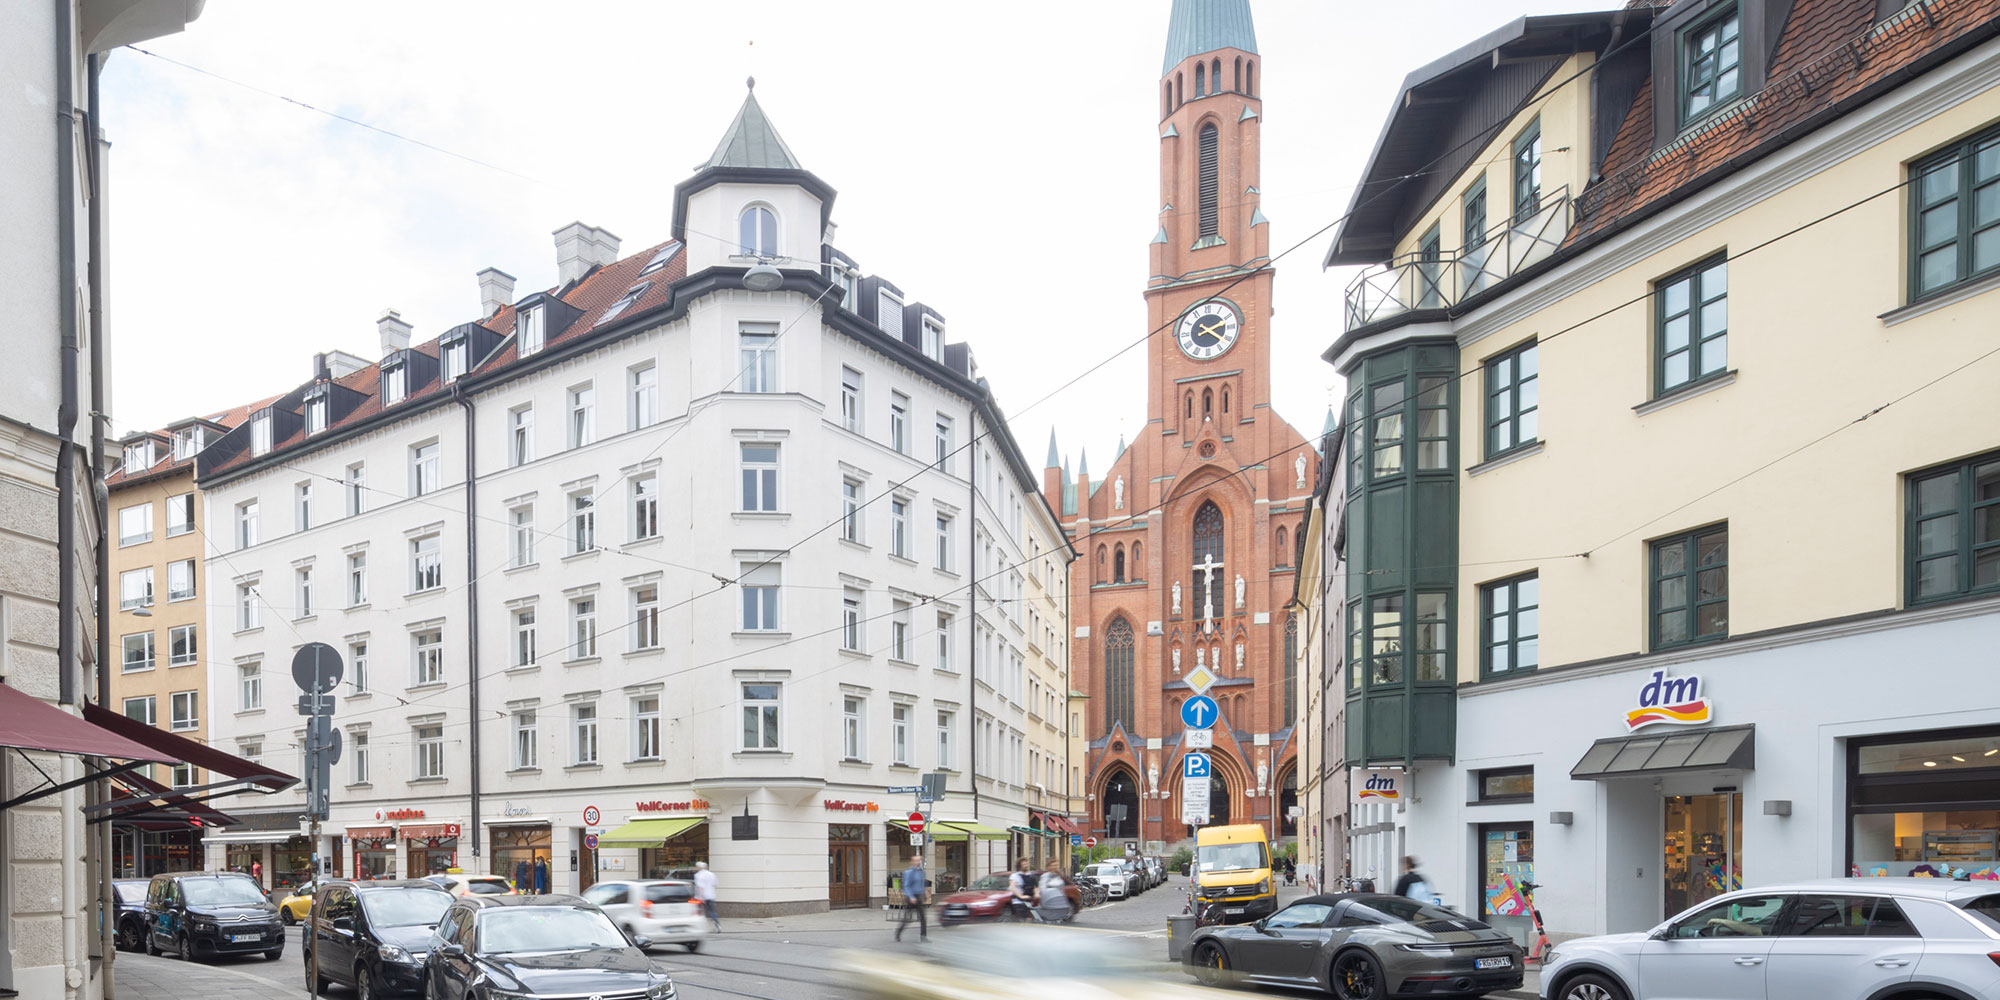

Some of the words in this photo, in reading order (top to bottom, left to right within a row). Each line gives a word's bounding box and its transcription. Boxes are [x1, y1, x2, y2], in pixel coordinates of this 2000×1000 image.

[1640, 670, 1699, 708] dm
[1187, 756, 1203, 776] P
[1365, 773, 1395, 790] dm
[636, 800, 691, 812] VollCorner
[691, 798, 710, 811] Bio
[824, 799, 867, 811] VollCorner
[866, 801, 879, 812] Bio
[386, 808, 424, 820] vodafone
[586, 811, 598, 821] 30
